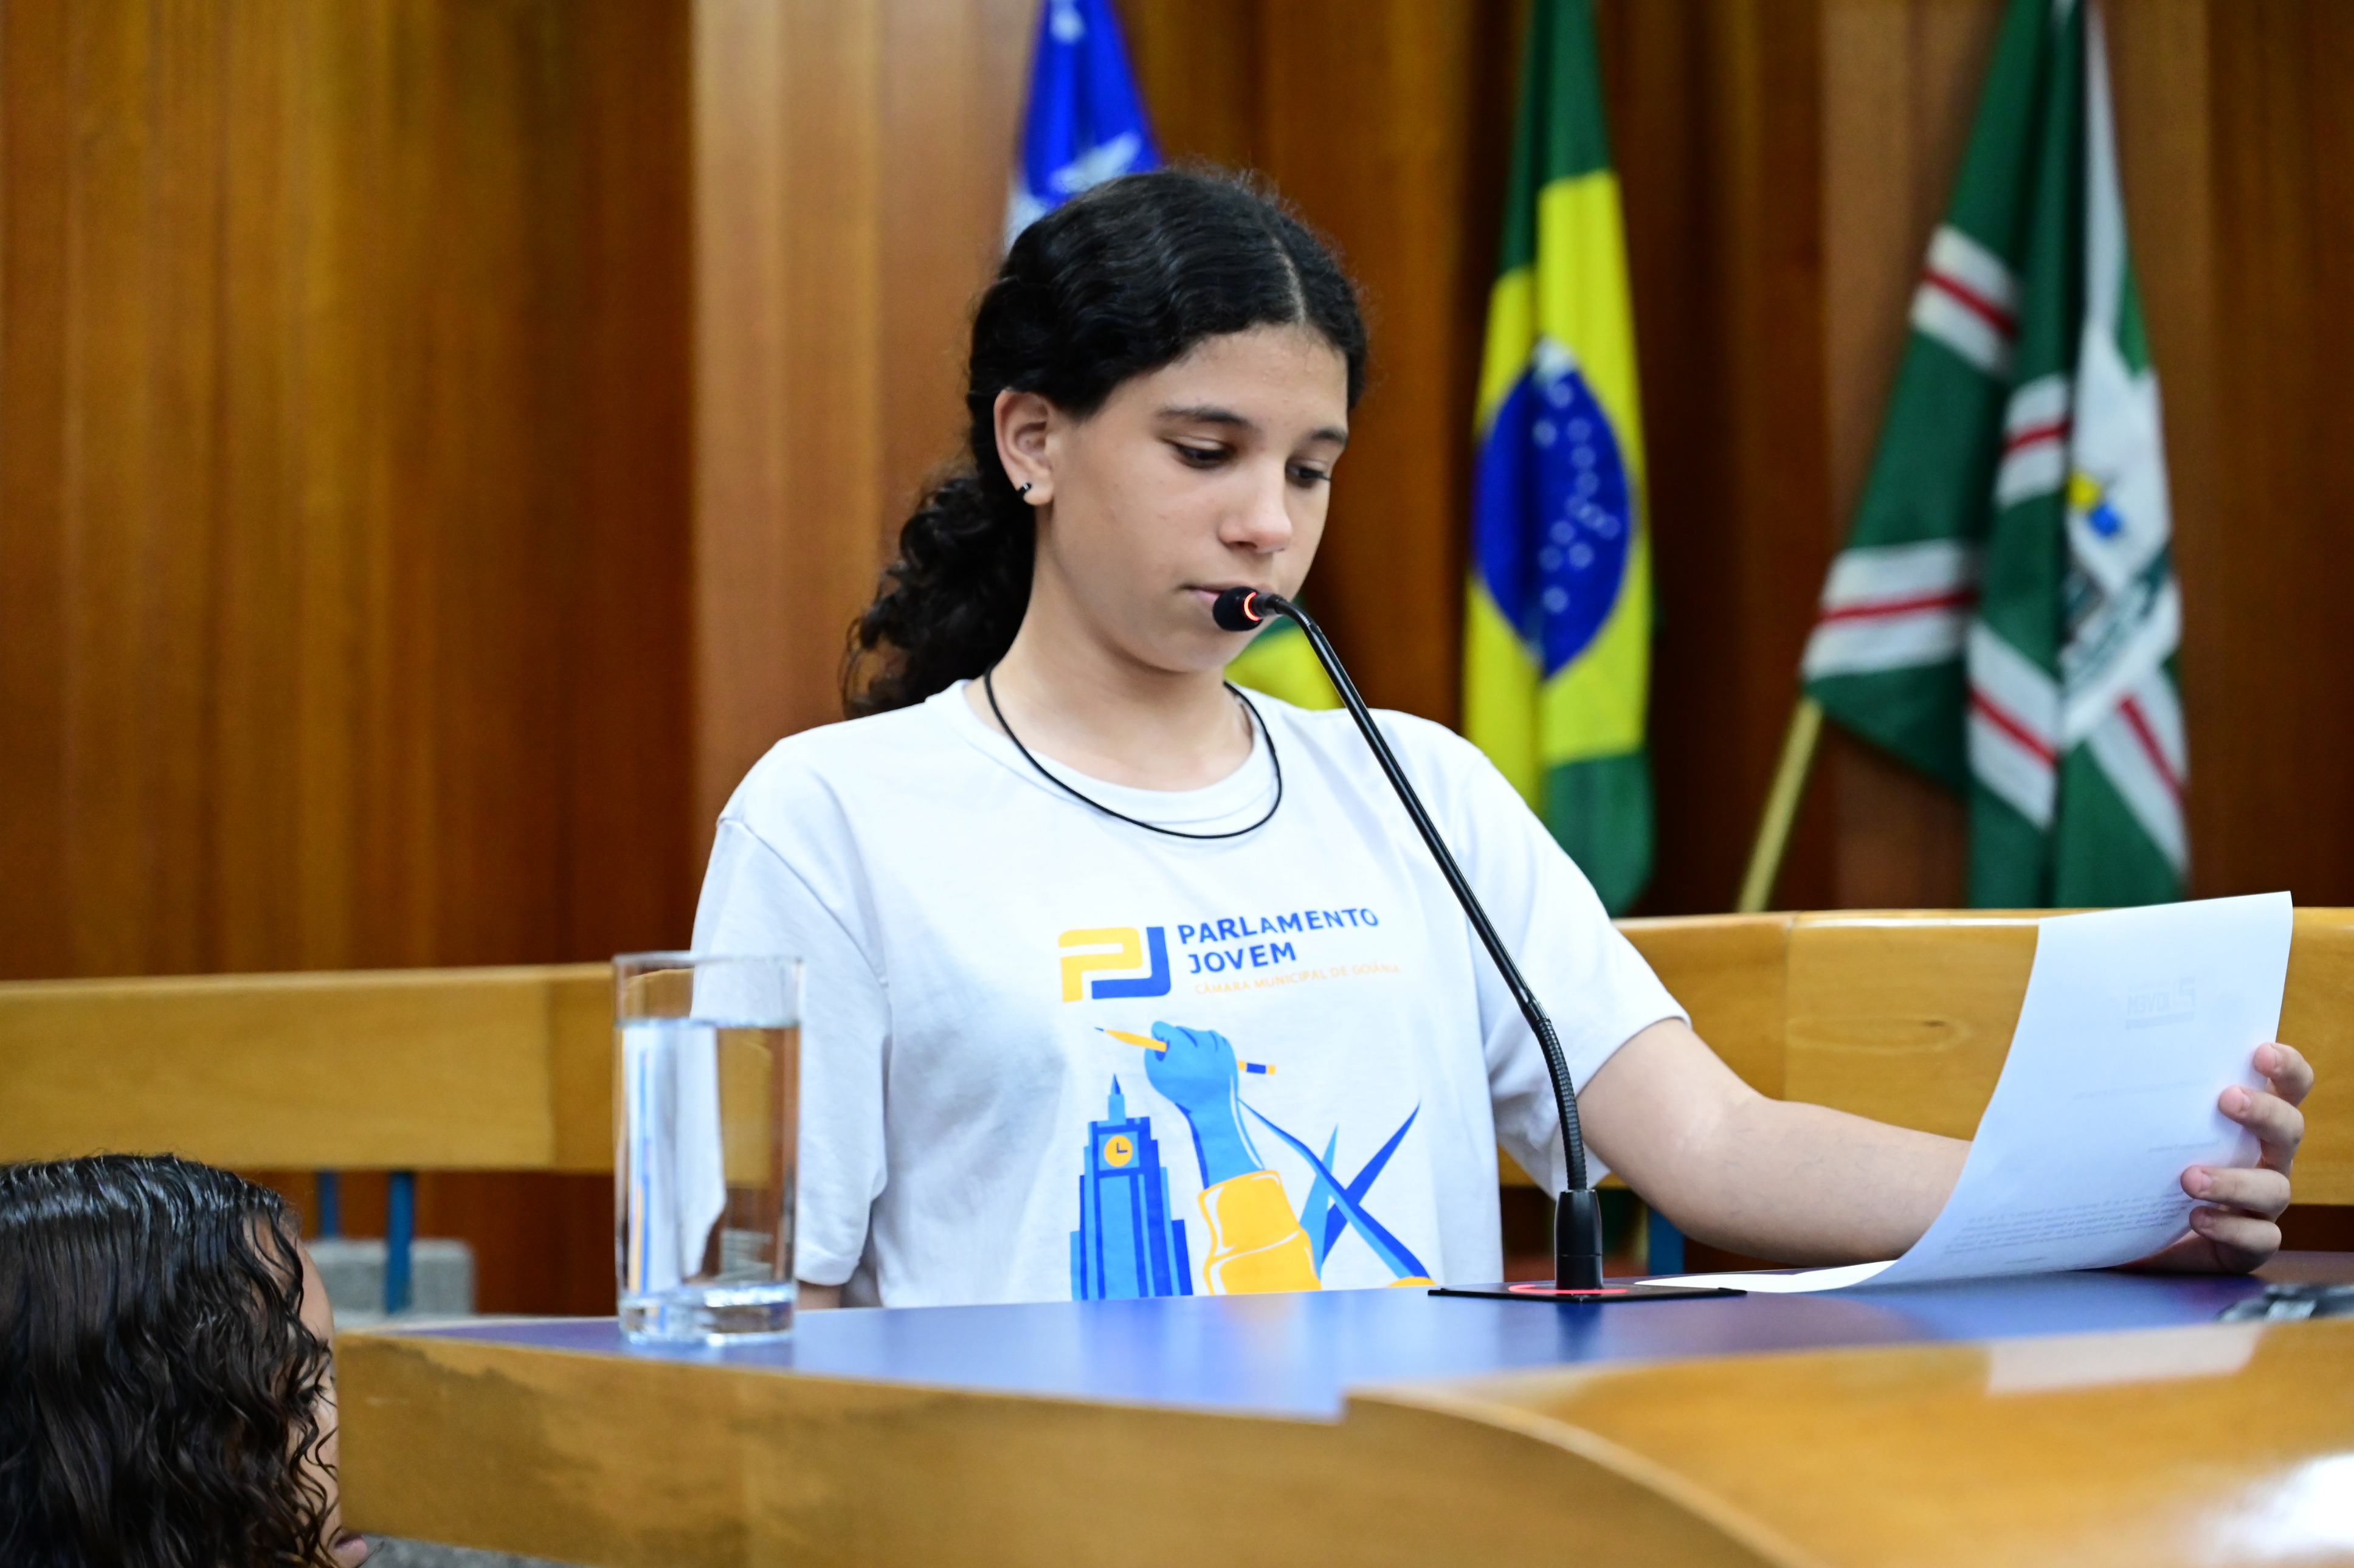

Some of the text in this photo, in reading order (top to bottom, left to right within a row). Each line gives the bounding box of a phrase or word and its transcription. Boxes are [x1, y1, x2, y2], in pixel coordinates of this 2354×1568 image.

[1177, 908, 1379, 944] PARLAMENTO
[1188, 942, 1296, 973] JOVEM
[1254, 968, 1328, 988] MUNICIPAL
[1330, 965, 1349, 978] DE
